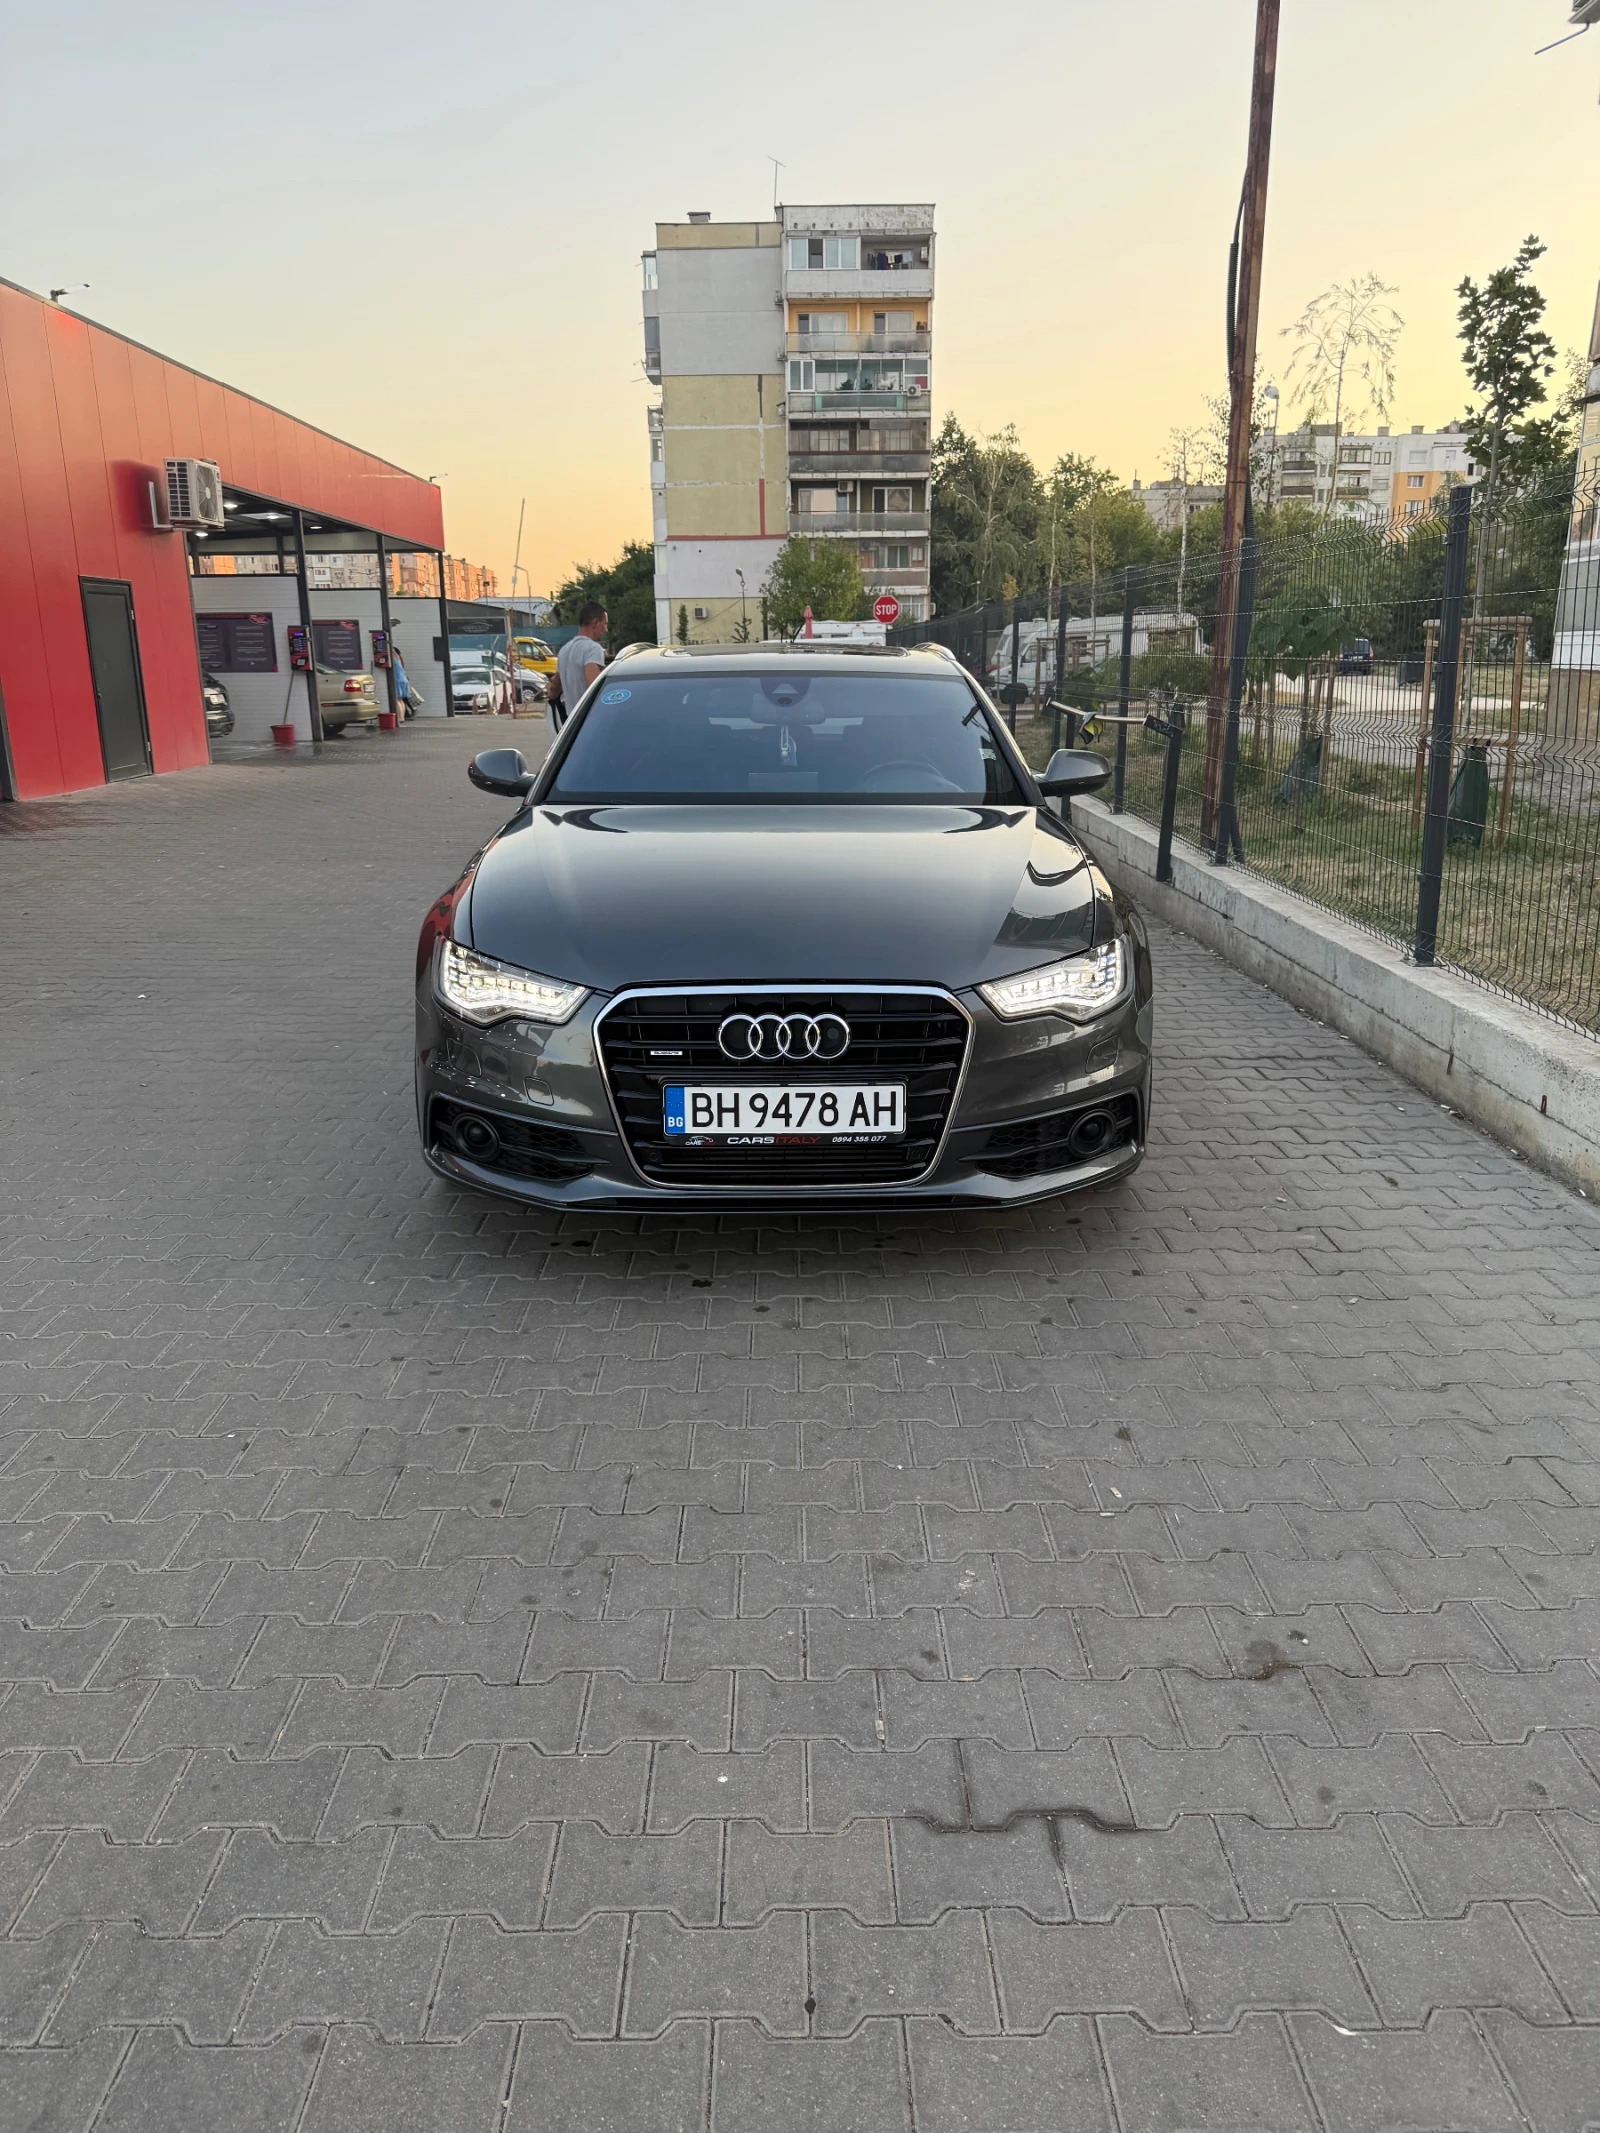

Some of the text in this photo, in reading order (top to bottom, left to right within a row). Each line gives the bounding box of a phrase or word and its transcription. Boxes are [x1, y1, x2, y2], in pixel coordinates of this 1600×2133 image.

[876, 604, 897, 615] STOP
[692, 1091, 896, 1128] BH 9478 AH
[667, 1116, 684, 1127] BG
